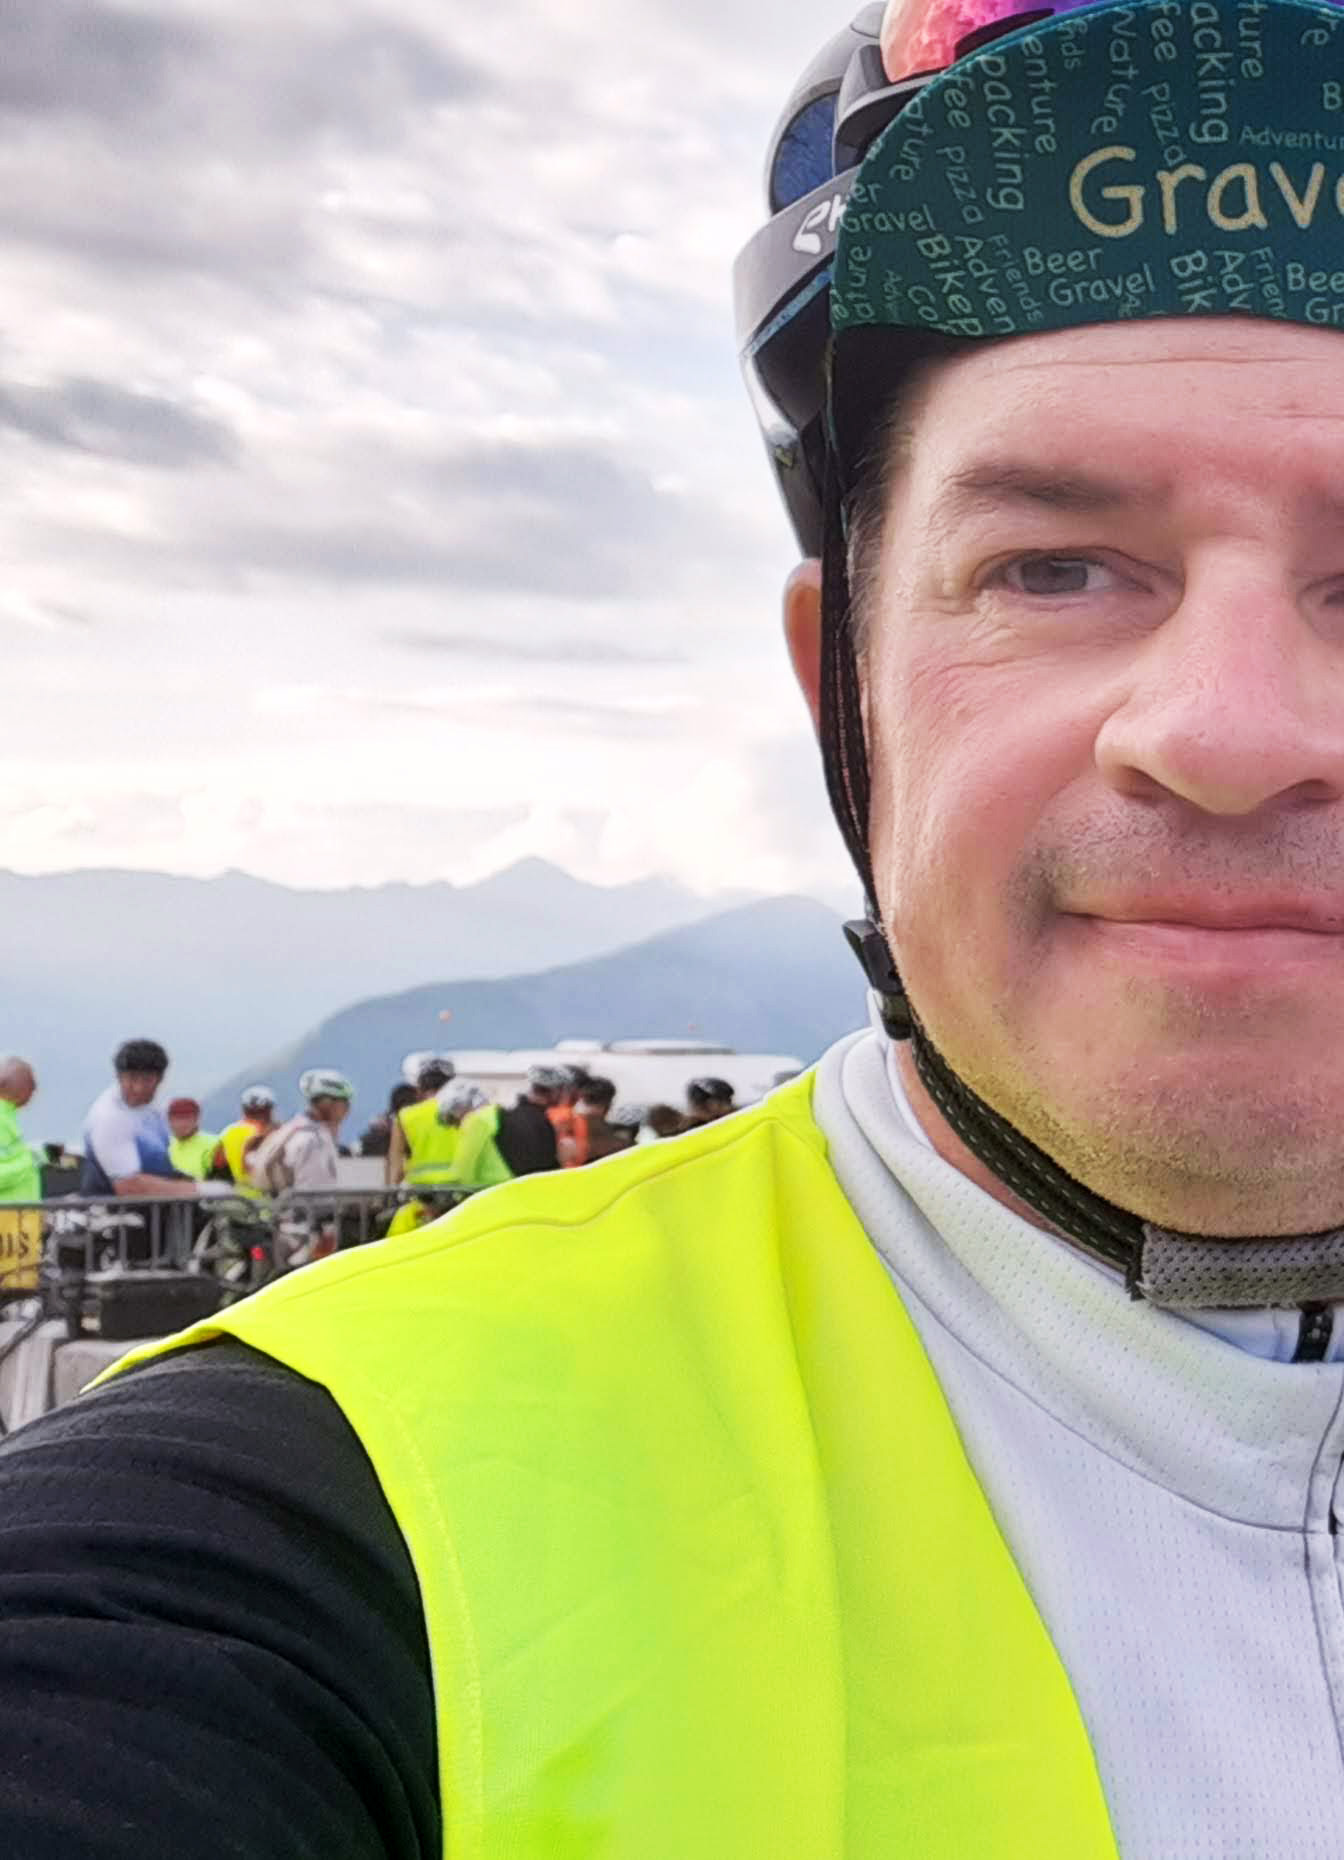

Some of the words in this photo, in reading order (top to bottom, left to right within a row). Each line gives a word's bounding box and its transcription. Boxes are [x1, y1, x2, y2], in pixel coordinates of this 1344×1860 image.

[840, 203, 937, 233] Gravel
[1022, 246, 1104, 275] Beer
[1049, 262, 1156, 307] Gravel
